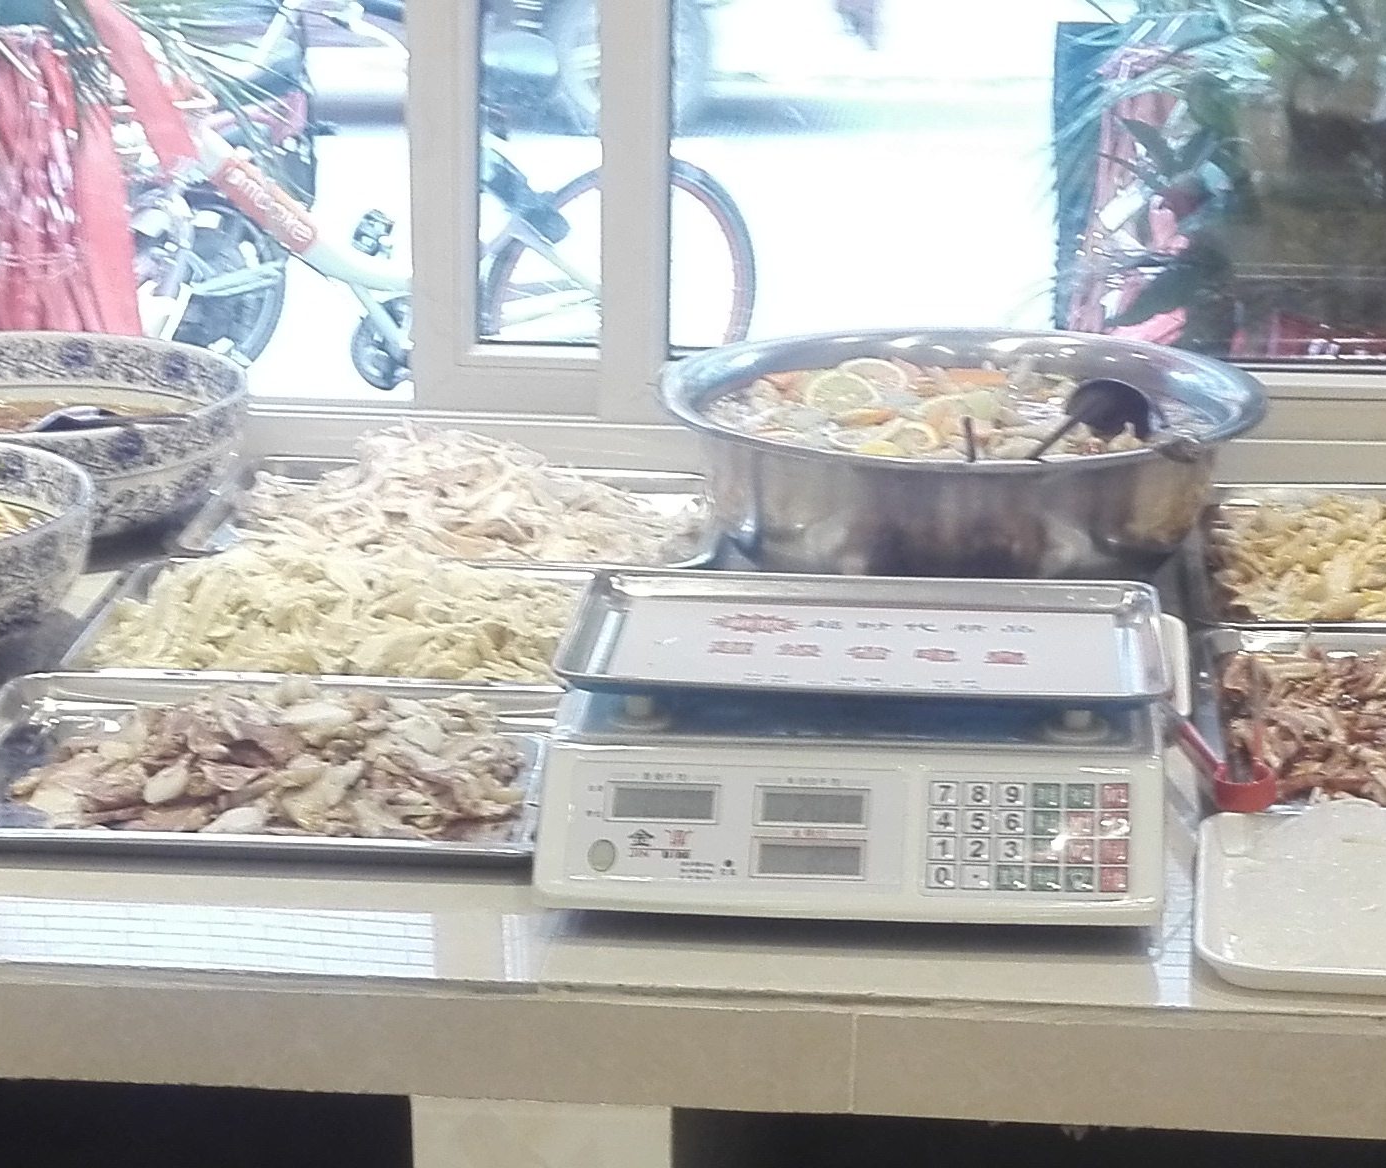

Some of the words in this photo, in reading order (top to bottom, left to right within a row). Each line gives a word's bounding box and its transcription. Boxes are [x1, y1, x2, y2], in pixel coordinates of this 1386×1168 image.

[937, 785, 952, 801] 7
[971, 785, 984, 803] 8
[1006, 786, 1019, 803] 9
[936, 812, 951, 828] 4
[971, 812, 986, 830] 5
[1005, 813, 1019, 830] 6
[936, 840, 948, 857] 1
[969, 840, 983, 857] 2
[1005, 840, 1018, 858] 3
[934, 866, 948, 883] 0
